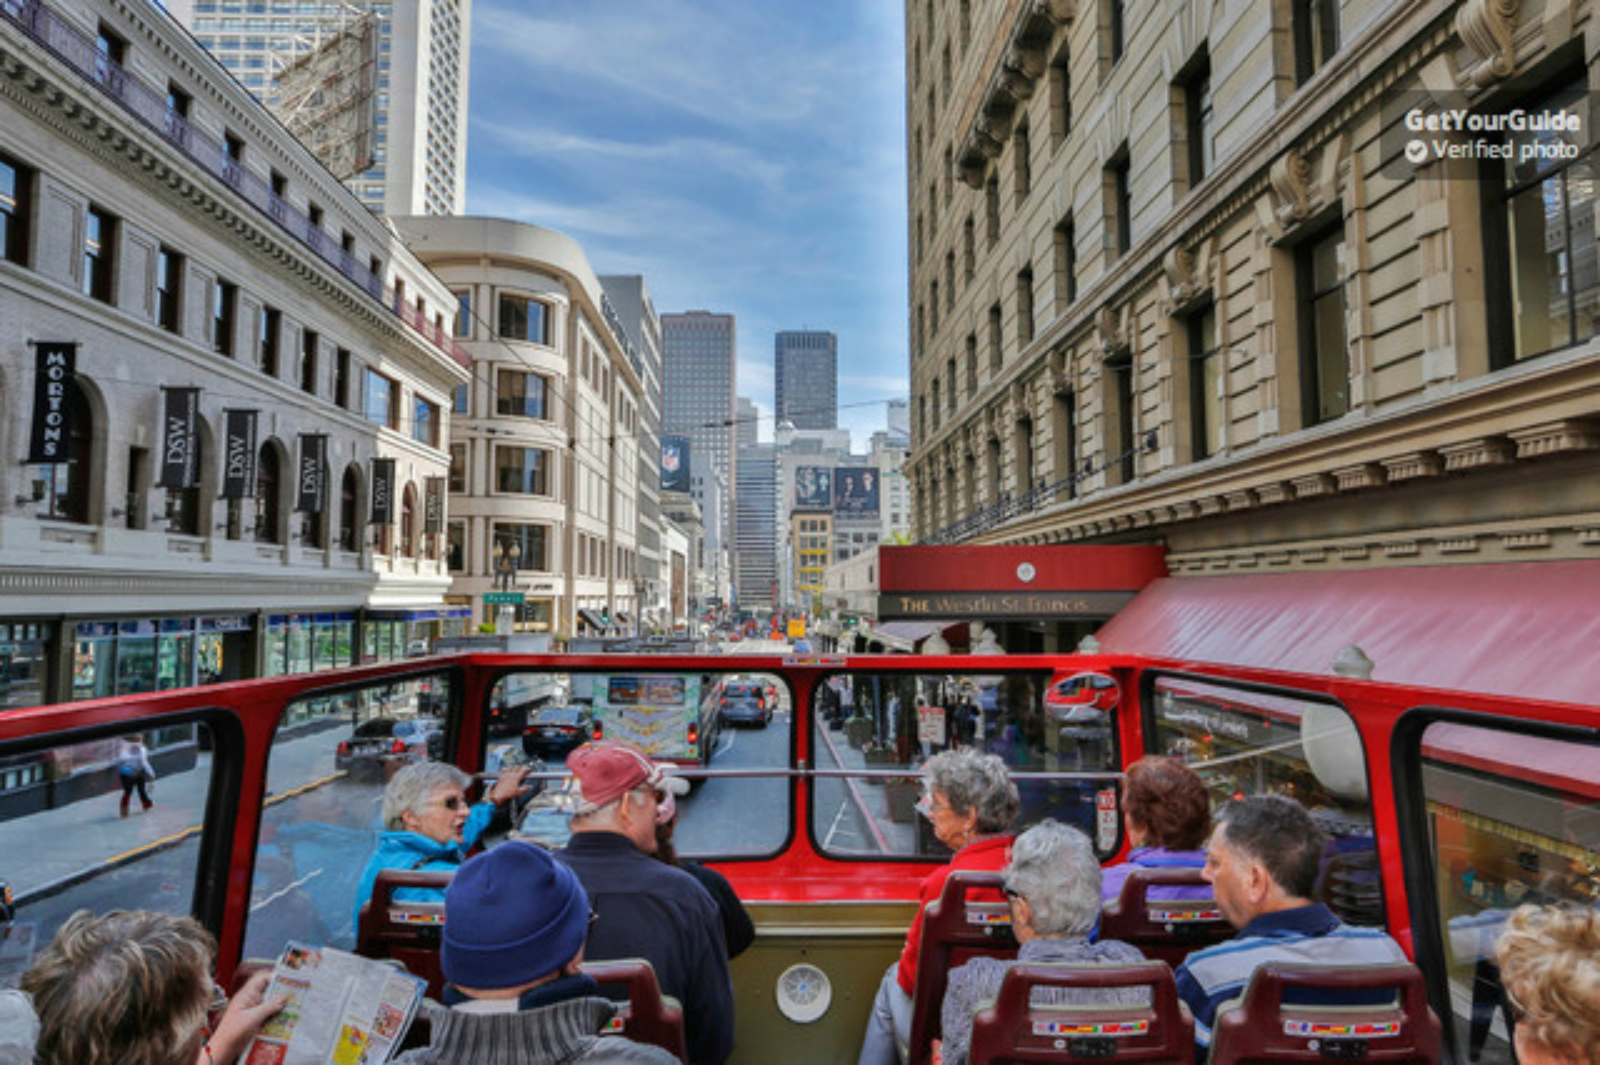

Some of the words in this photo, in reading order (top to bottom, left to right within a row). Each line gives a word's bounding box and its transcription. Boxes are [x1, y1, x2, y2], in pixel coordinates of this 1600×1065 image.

[44, 351, 66, 456] MORTONS
[167, 416, 186, 464] DSW
[229, 434, 245, 478] DSW
[301, 456, 317, 494] DSW
[374, 477, 386, 509] DSW
[936, 595, 997, 613] Westin
[1028, 597, 1088, 613] Francis
